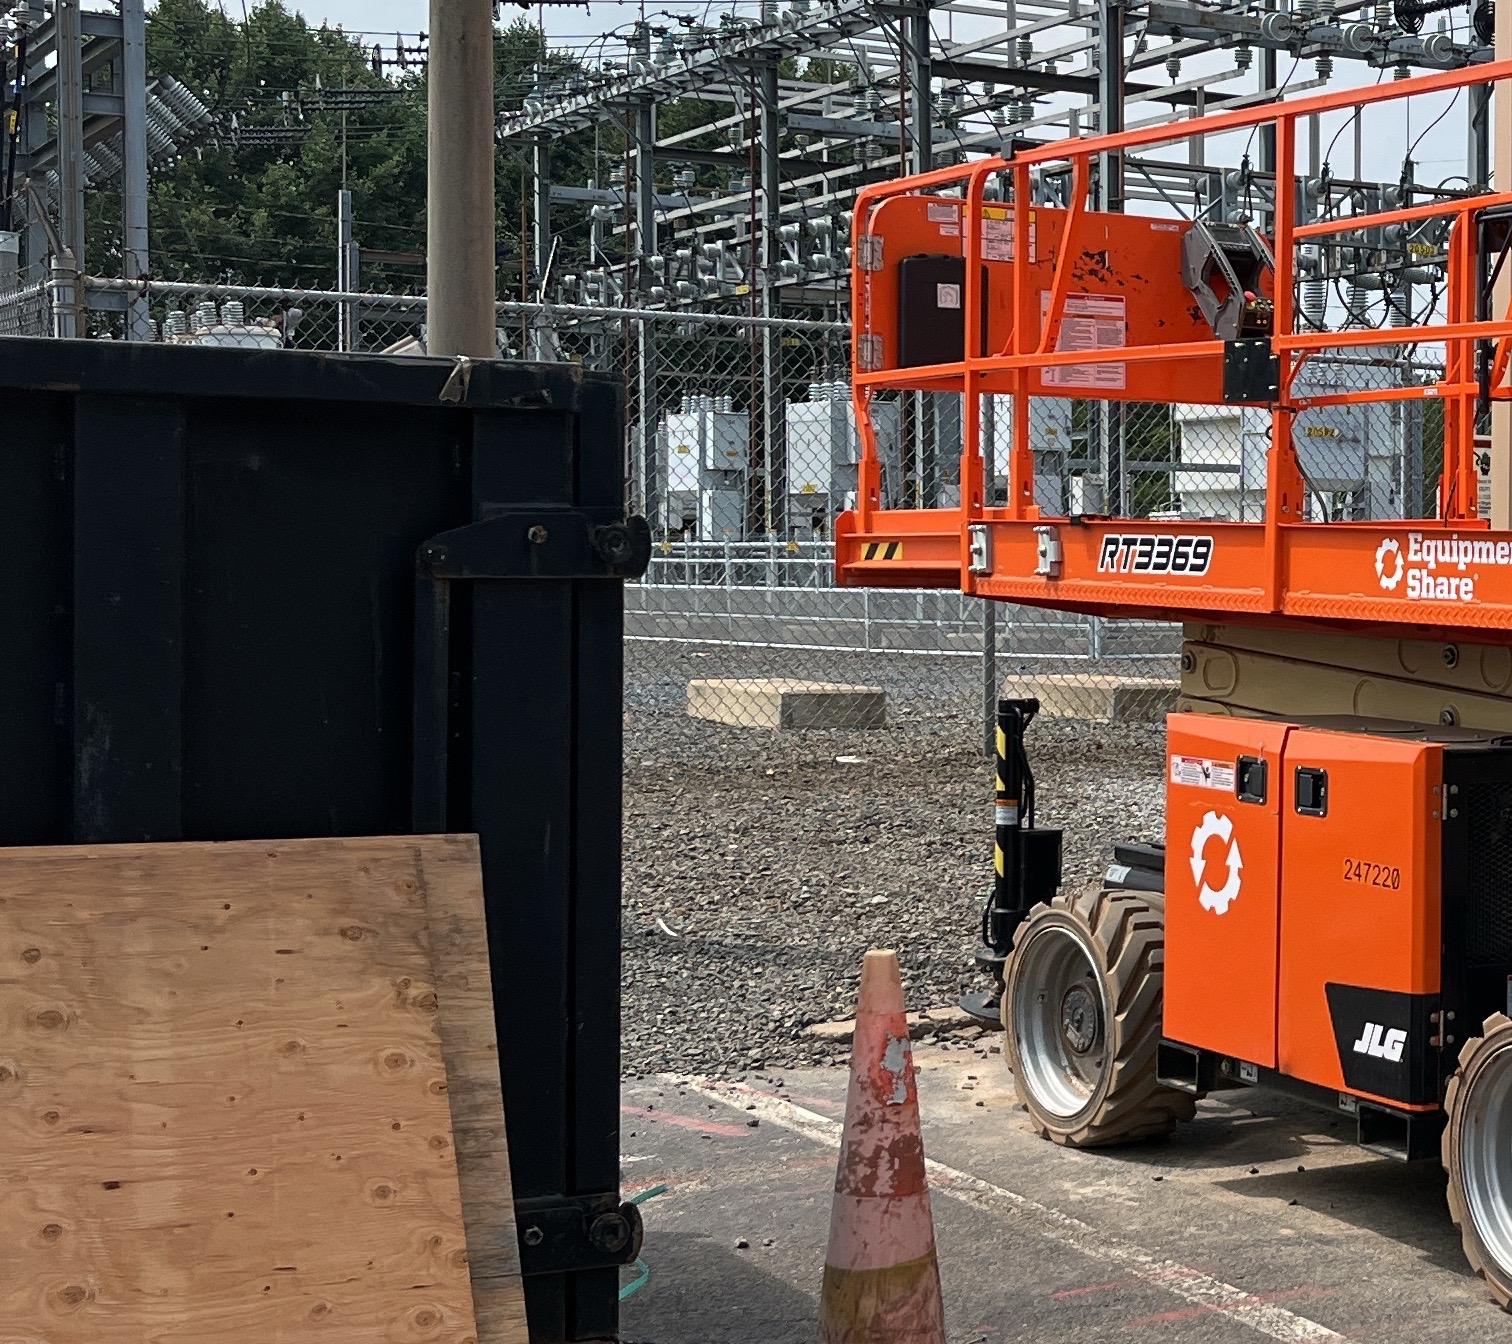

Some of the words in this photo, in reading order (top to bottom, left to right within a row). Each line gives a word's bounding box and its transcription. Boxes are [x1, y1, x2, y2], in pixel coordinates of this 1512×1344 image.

[1098, 535, 1213, 575] RT3369
[1406, 568, 1474, 601] Share
[1343, 858, 1401, 890] 247220
[1353, 1022, 1408, 1062] JLG
